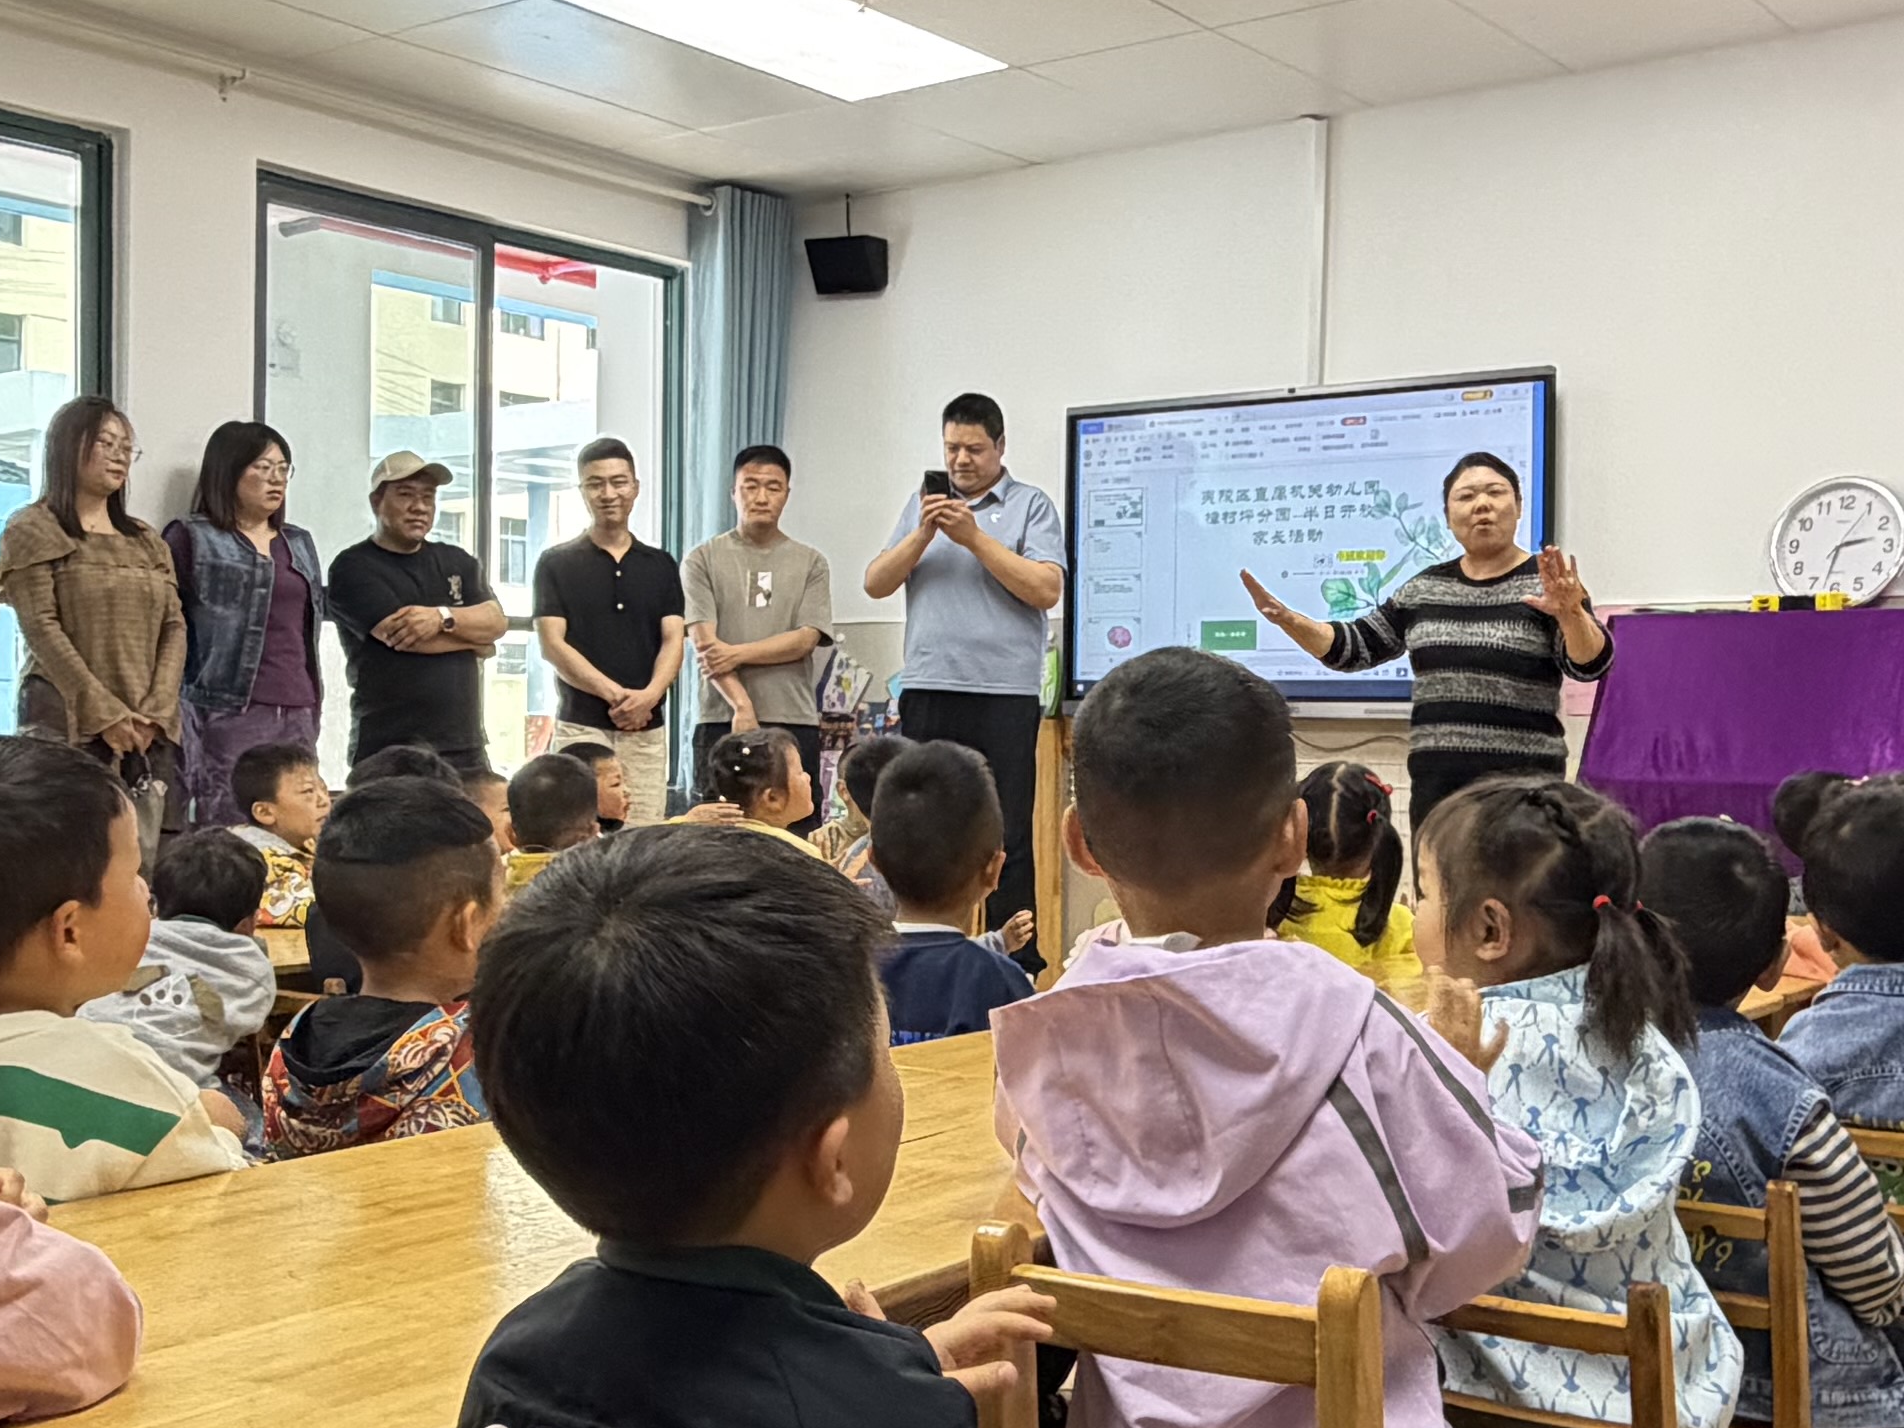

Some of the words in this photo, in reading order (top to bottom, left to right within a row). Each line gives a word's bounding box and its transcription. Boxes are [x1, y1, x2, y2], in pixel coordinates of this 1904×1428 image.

[1817, 500, 1832, 516] 11
[1839, 495, 1856, 510] 12
[1866, 501, 1872, 516] 1
[1798, 517, 1813, 532] 10
[1878, 516, 1890, 531] 2
[1789, 538, 1800, 554] 9
[1882, 538, 1894, 553] 3
[1793, 561, 1804, 576] 8
[1872, 561, 1883, 576] 4
[1808, 577, 1819, 590] 7
[1852, 577, 1864, 592] 5
